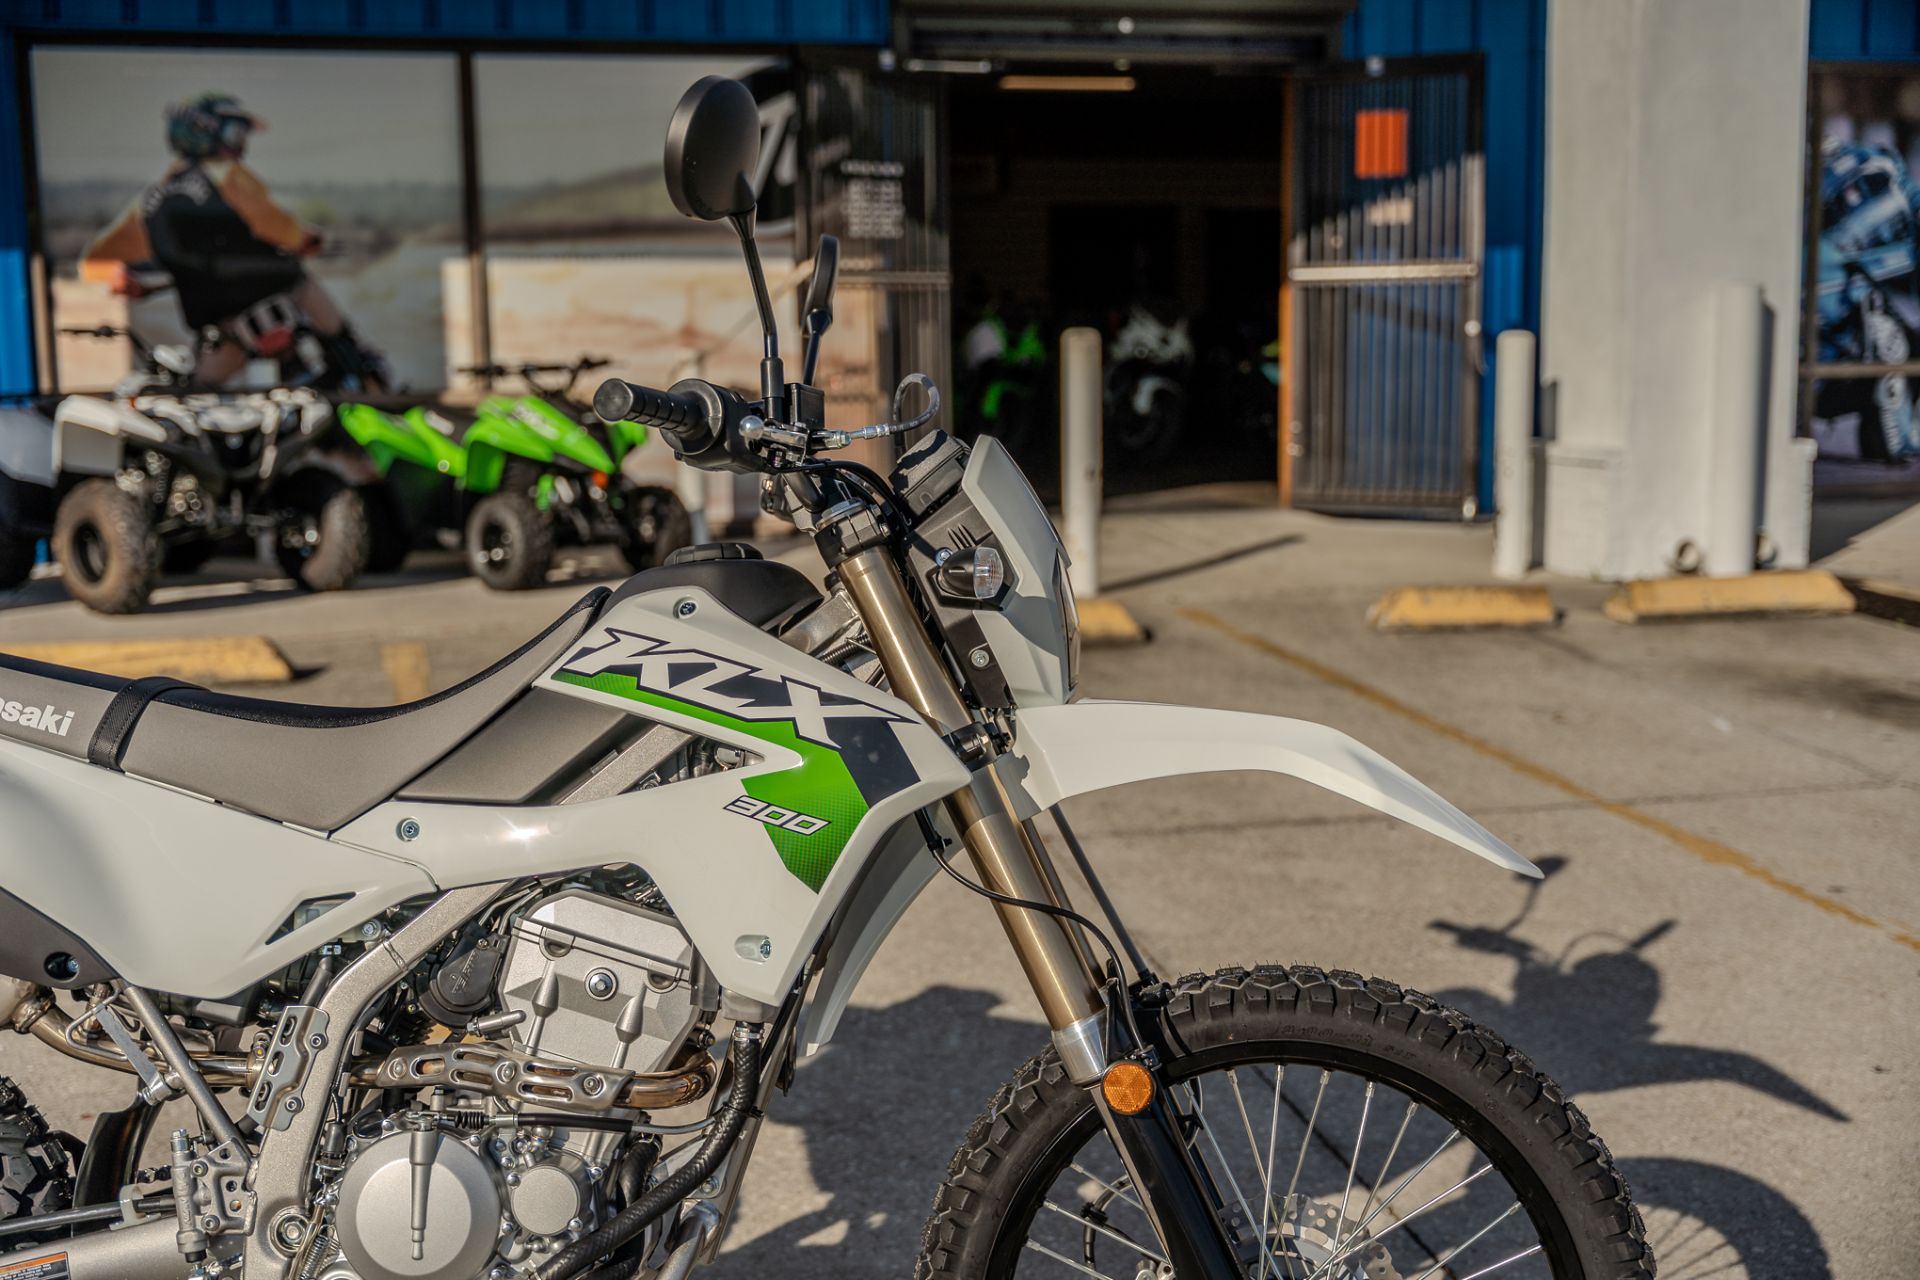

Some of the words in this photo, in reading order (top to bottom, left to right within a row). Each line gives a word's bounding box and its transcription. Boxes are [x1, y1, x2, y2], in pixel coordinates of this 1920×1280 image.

[562, 627, 920, 749] KLX
[0, 697, 75, 737] saki
[724, 794, 832, 836] 300
